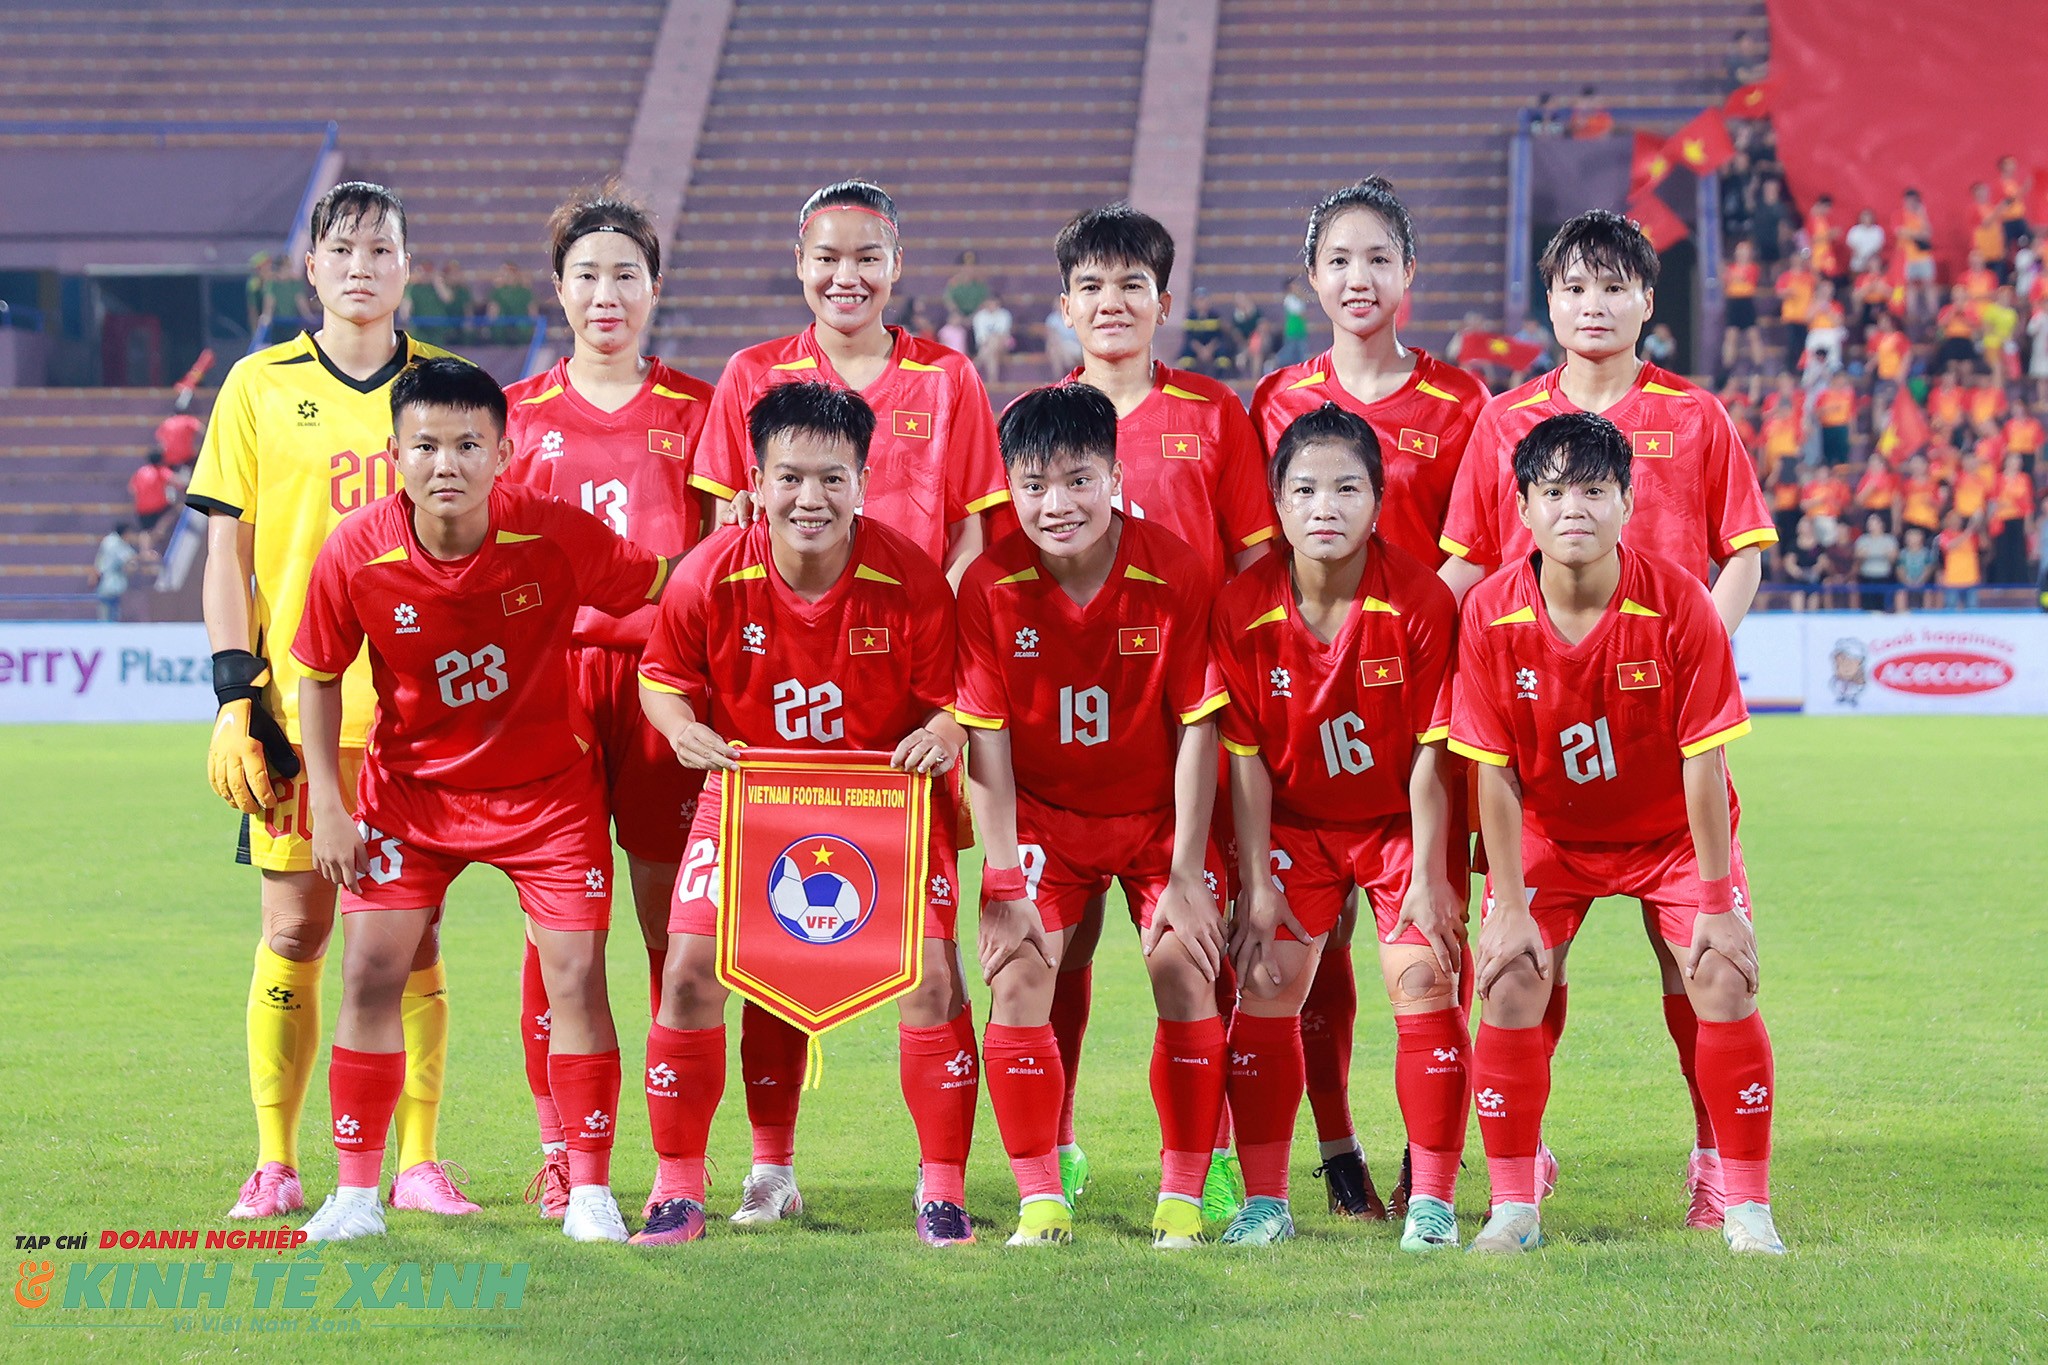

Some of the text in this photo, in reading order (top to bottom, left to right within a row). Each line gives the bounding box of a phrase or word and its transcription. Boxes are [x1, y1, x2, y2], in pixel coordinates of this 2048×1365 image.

[331, 450, 396, 515] 20
[580, 478, 628, 538] 13
[435, 643, 509, 708] 23
[773, 677, 844, 743] 22
[1060, 685, 1109, 746] 19
[1319, 710, 1375, 778] 16
[1559, 716, 1618, 785] 21
[747, 785, 905, 808] VIETNAM FOOTBALL FEDERATION
[806, 915, 837, 929] VFF
